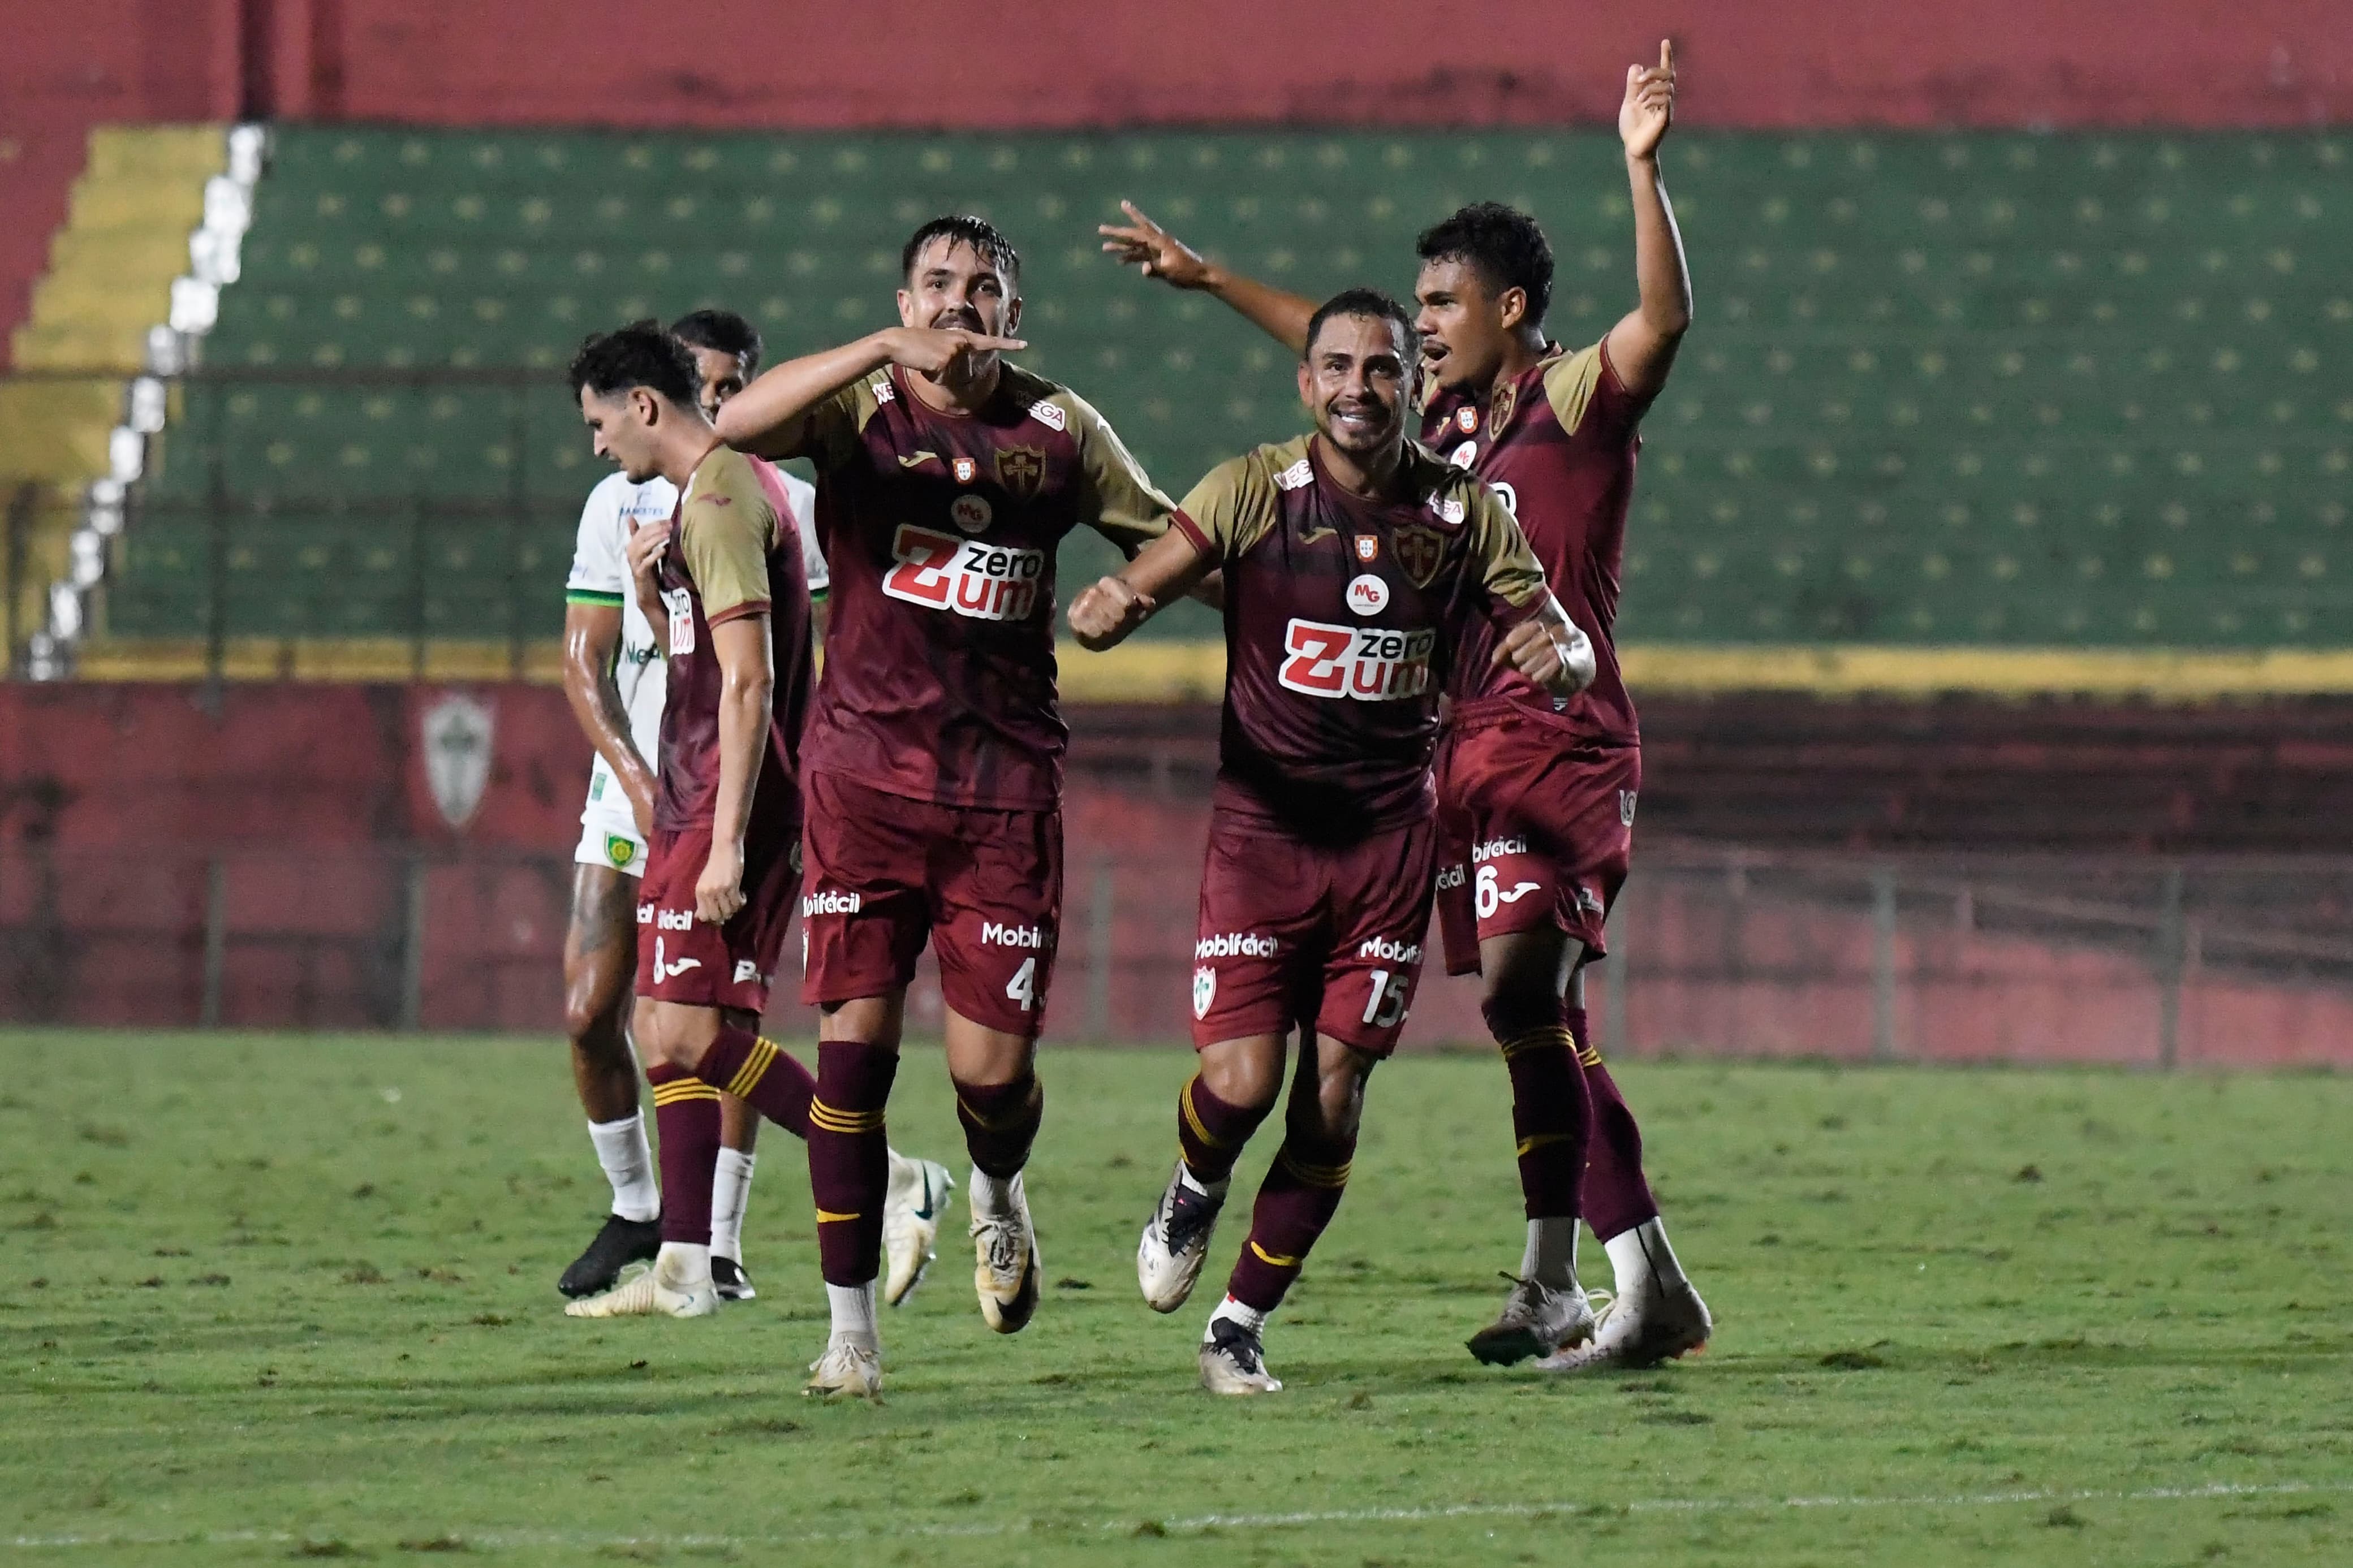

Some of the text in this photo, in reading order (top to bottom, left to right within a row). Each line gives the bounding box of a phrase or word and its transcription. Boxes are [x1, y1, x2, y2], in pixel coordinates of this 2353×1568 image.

[963, 546, 1040, 578] zero
[1355, 585, 1380, 603] MG
[1358, 632, 1433, 659] zero
[1435, 864, 1466, 891] ácil
[1473, 865, 1499, 922] 6
[1360, 936, 1423, 965] Mobif
[1006, 957, 1036, 1012] 4
[1362, 969, 1409, 1028] 15
